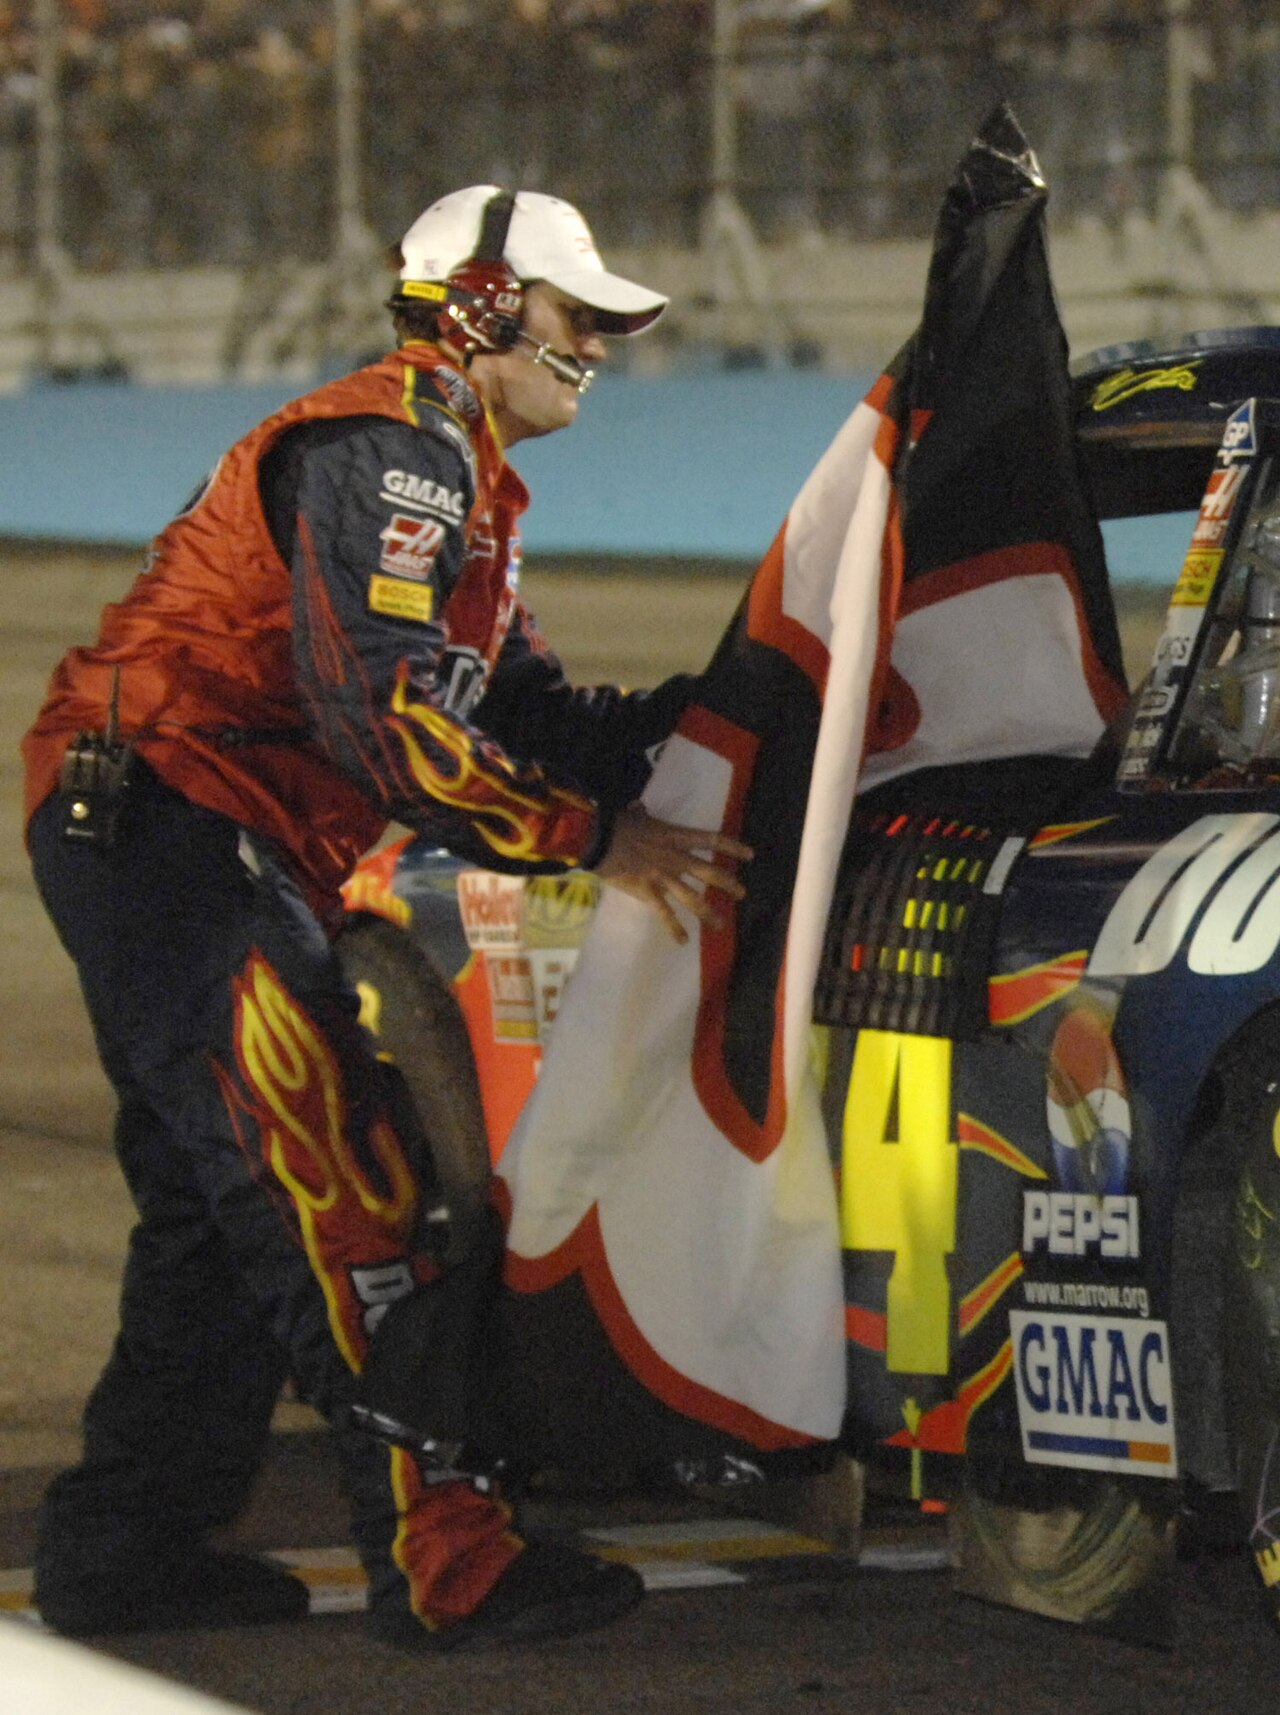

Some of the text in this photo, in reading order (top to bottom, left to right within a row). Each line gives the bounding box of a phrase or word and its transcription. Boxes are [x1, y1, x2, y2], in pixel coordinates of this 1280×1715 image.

[1023, 1191, 1139, 1258] PEPSI
[1023, 1282, 1149, 1317] www.marrow.org
[1019, 1322, 1168, 1425] GMAC
